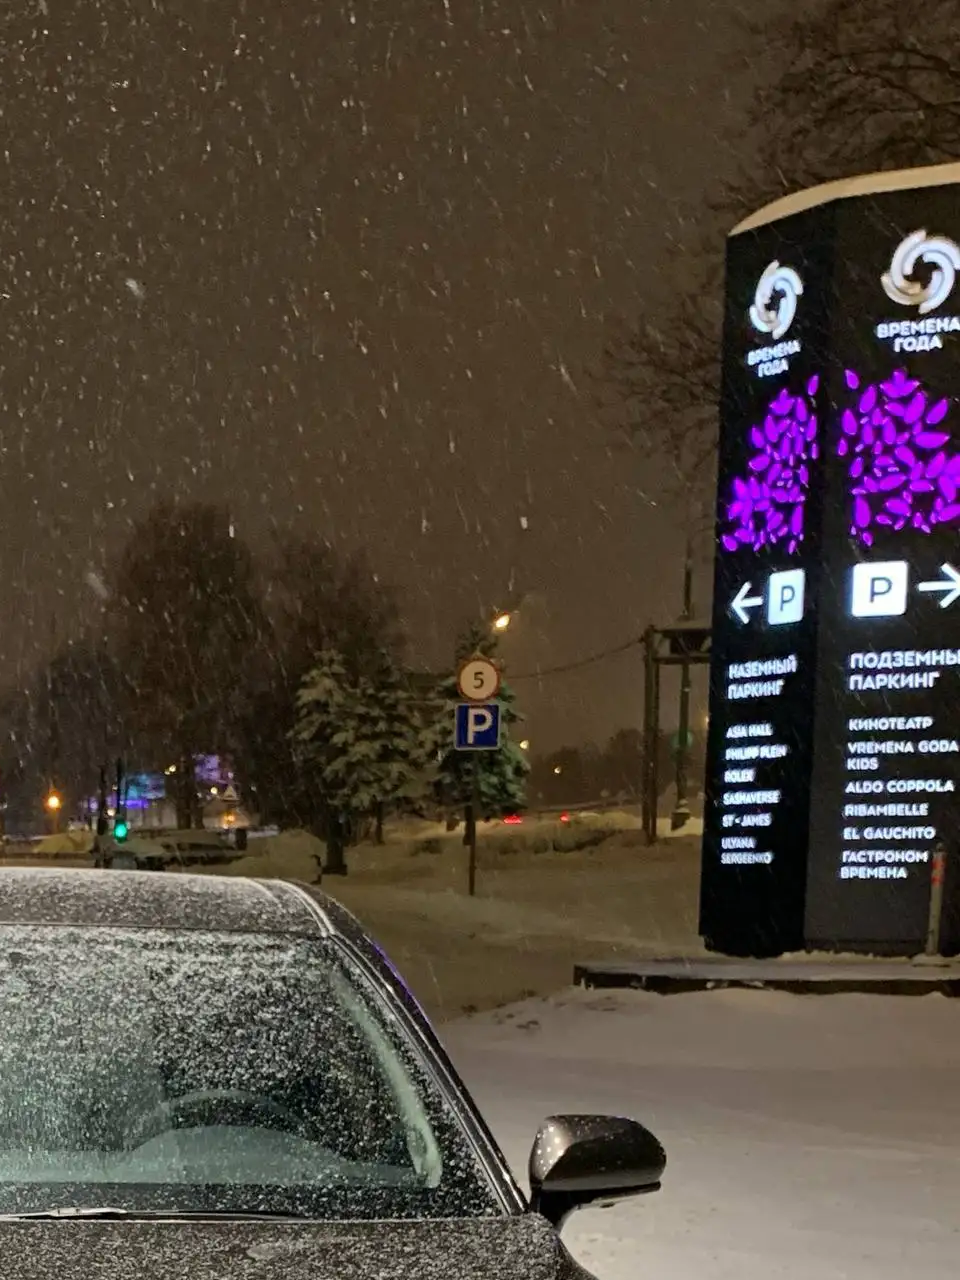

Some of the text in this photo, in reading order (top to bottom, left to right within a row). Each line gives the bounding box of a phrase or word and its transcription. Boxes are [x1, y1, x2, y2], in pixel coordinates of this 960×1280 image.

[876, 316, 960, 338] ВРЕМЕНА
[747, 340, 801, 366] ВРЕМЕНА
[894, 334, 943, 353] ГОДА
[757, 358, 789, 378] ГОДА
[728, 654, 797, 679] НАЗЕМНЫЙ
[472, 671, 485, 690] 5
[727, 679, 784, 699] ПАРКИНГ
[849, 671, 940, 690] ПАРКИНГ
[466, 707, 493, 745] P
[848, 716, 934, 731] КИНОТЕАТР
[847, 740, 959, 754] VREMENA GODA
[846, 757, 879, 771] KIDS
[845, 780, 955, 793] ALDO COPPOLA
[844, 803, 929, 817] RIBAMBELLE
[843, 826, 936, 840] EL GAUCHITO
[842, 850, 929, 863] ГАСТРОНОМ
[840, 866, 908, 879] ВРЕМЕНА
